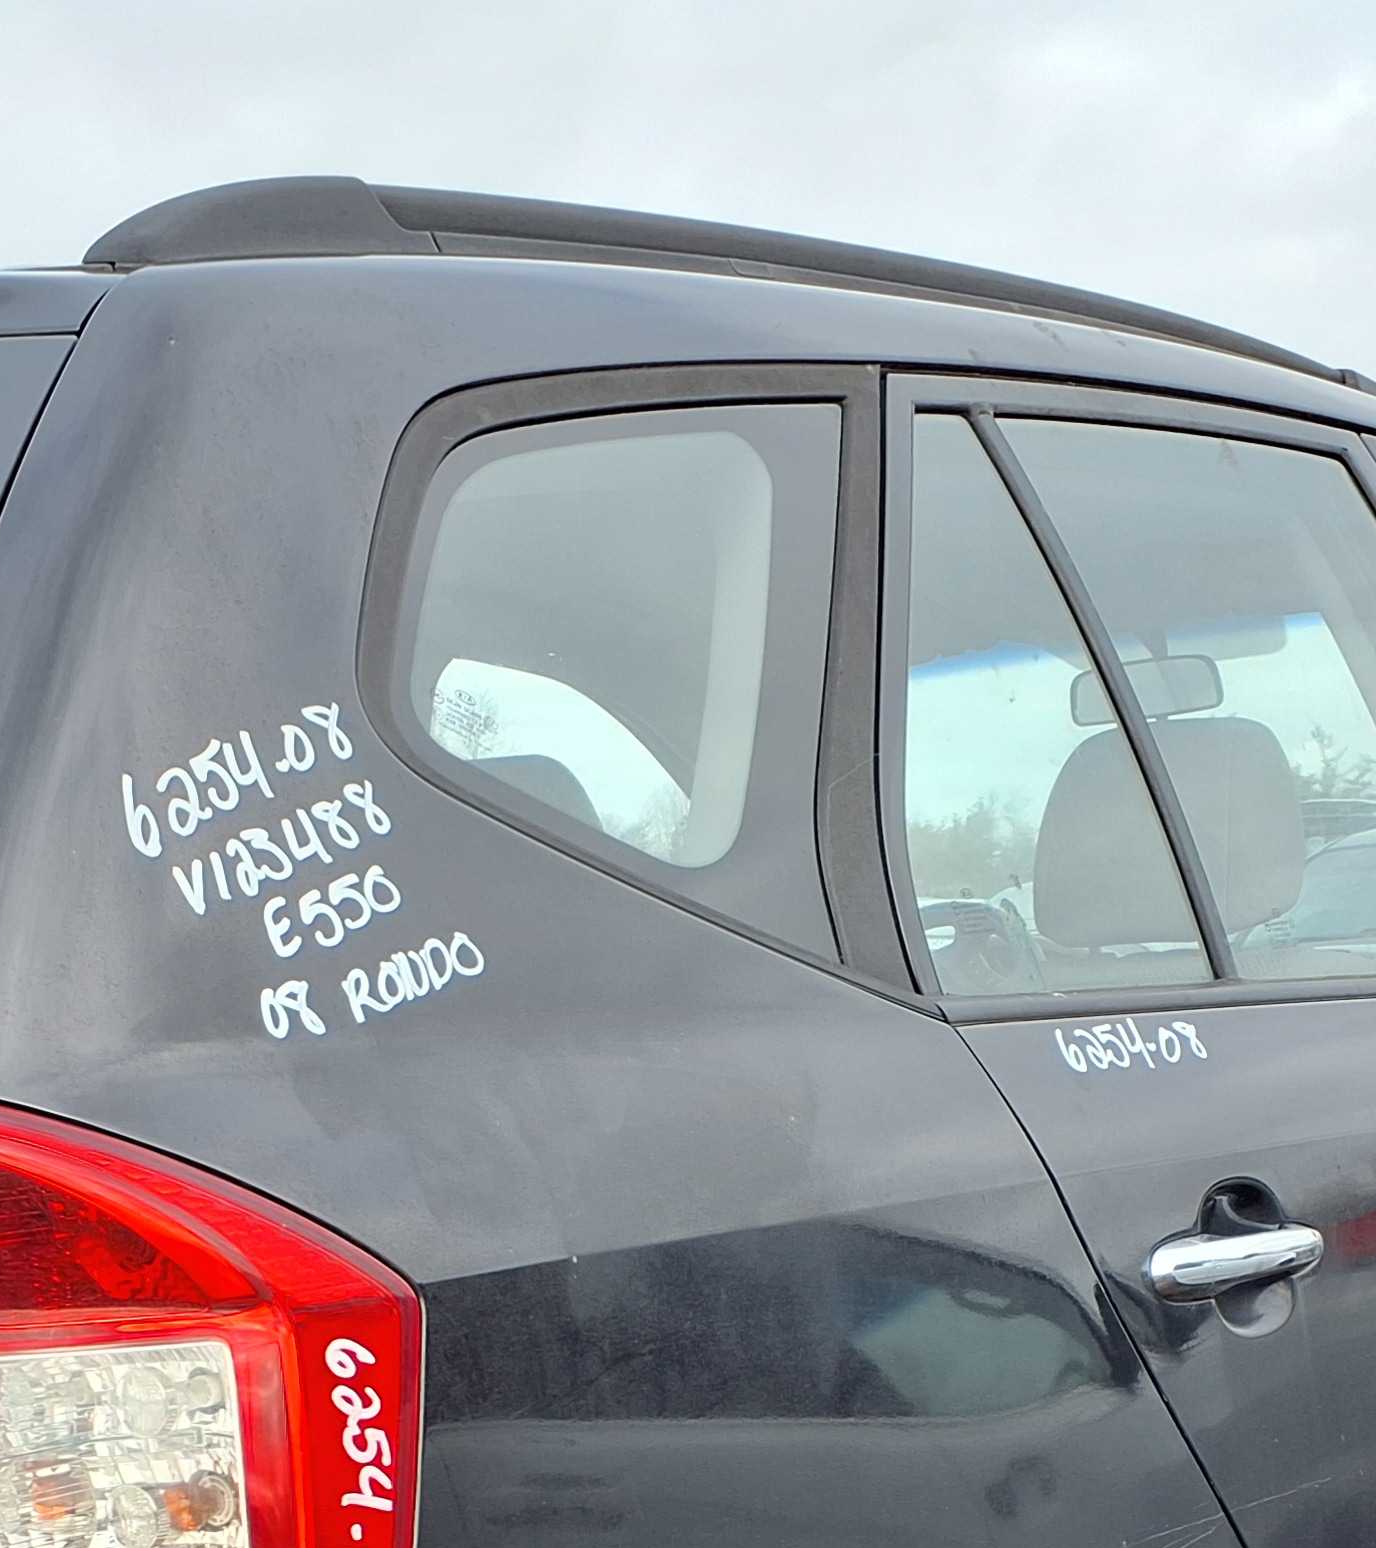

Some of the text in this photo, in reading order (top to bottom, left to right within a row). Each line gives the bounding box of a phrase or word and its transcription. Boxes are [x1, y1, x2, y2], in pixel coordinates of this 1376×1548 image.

[263, 865, 401, 957] E550
[260, 932, 485, 1039] 08 RONDO
